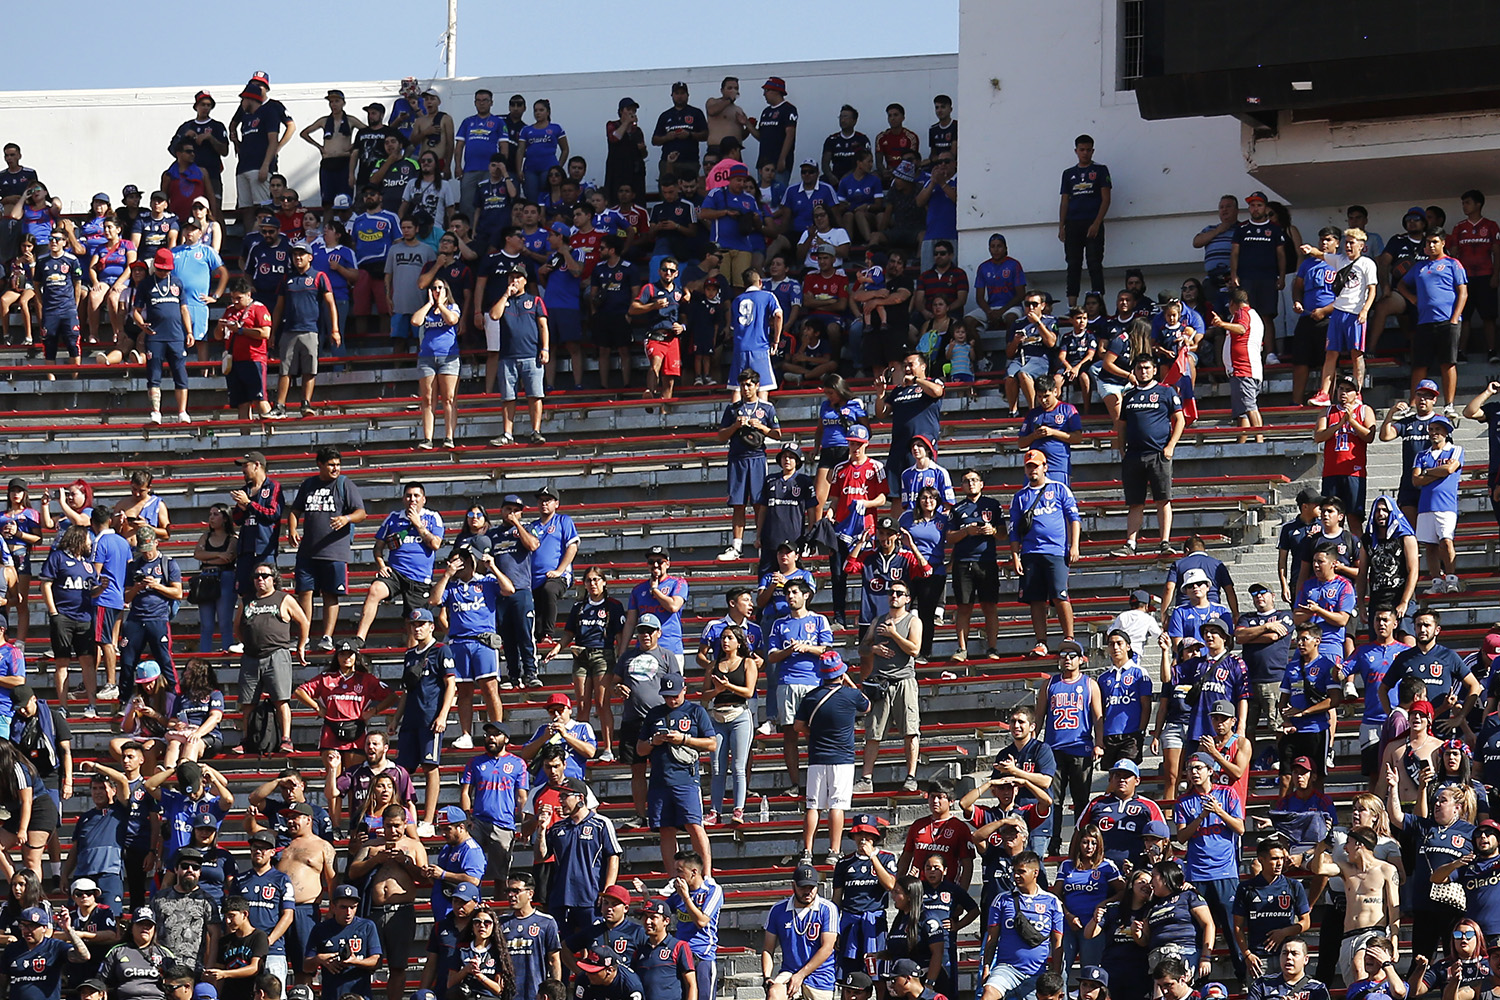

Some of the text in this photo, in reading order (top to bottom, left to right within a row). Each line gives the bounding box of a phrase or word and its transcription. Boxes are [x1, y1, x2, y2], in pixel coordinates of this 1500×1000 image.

[714, 170, 729, 181] 60
[271, 265, 285, 274] LG
[738, 300, 754, 325] 9
[1335, 432, 1349, 451] 11
[452, 598, 483, 612] Claro
[1053, 708, 1079, 730] 25
[1117, 819, 1136, 831] LG
[1425, 845, 1463, 857] PETROBRAS
[1064, 880, 1099, 893] Claro
[1258, 911, 1292, 919] PETROBRAS
[124, 965, 160, 979] Claro
